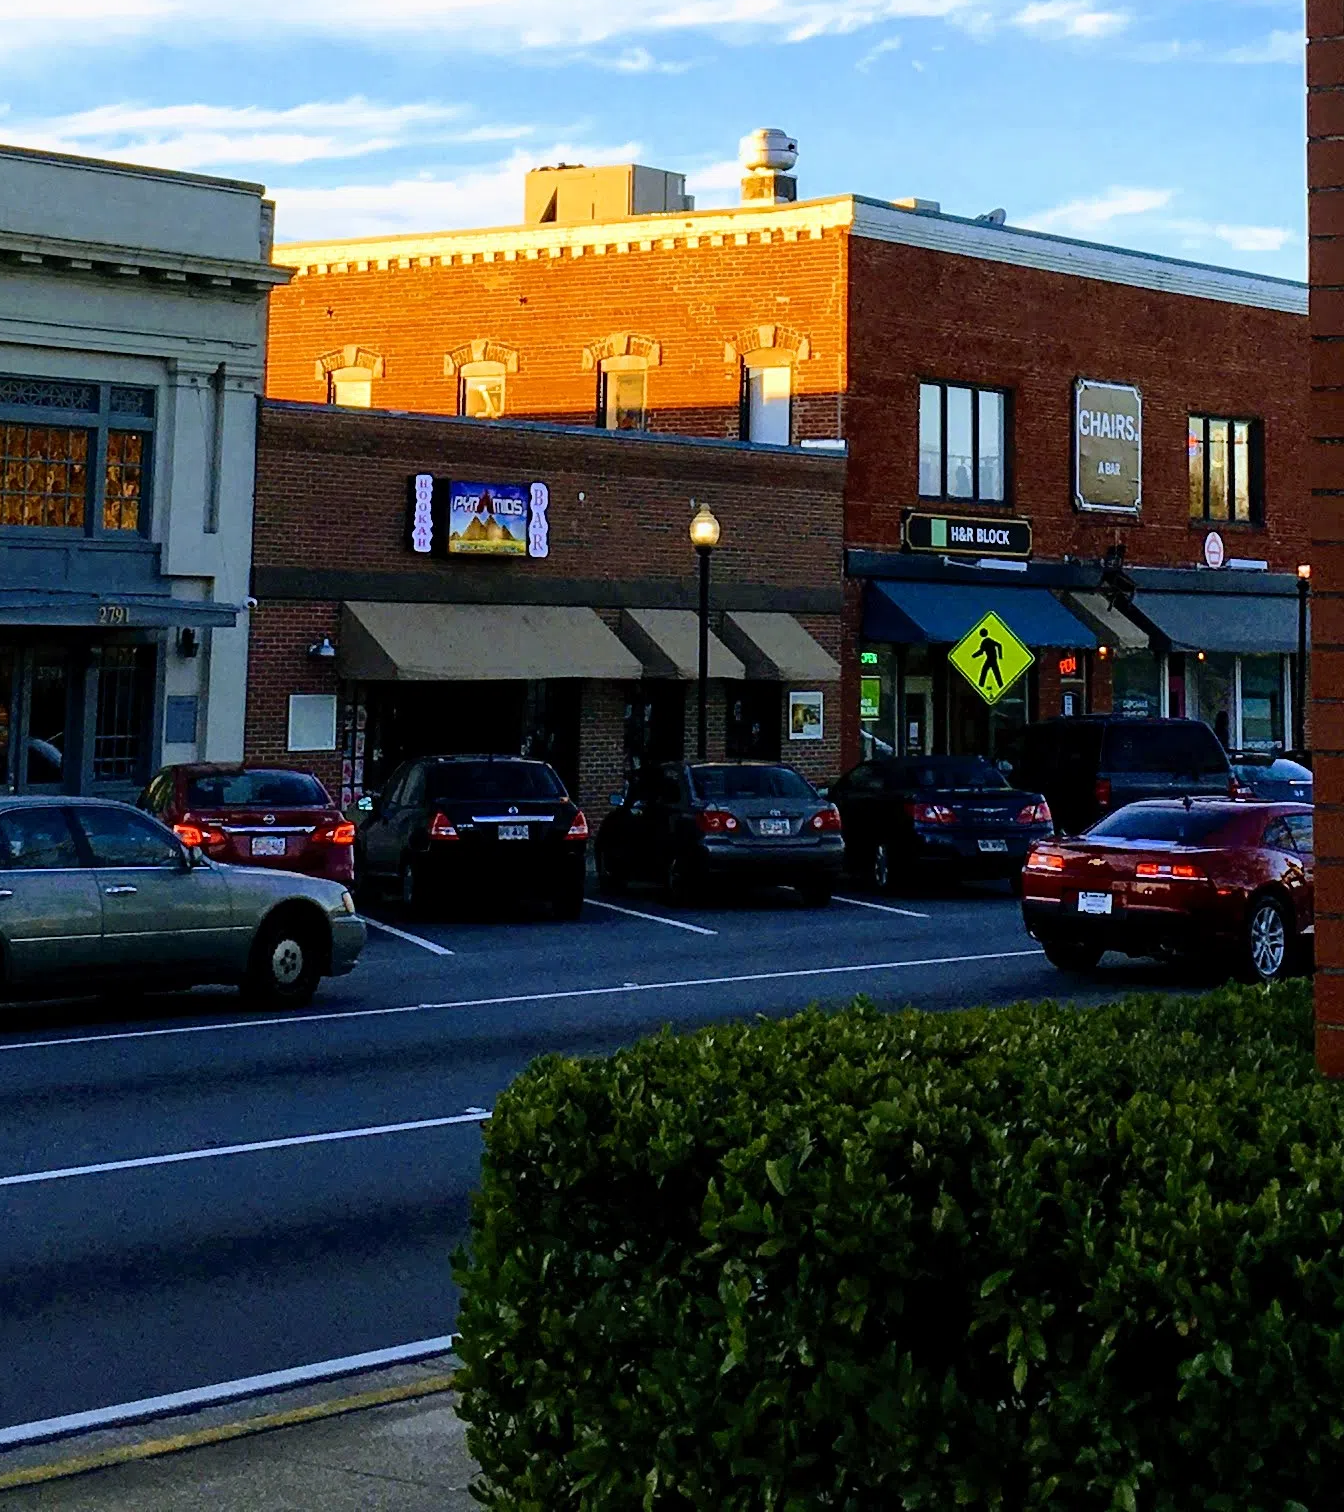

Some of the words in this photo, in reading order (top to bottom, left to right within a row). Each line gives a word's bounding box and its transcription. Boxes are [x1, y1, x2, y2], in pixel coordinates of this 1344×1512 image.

[1097, 461, 1104, 474] A
[418, 479, 428, 547] HOOKAH
[533, 489, 544, 551] BAR
[950, 526, 974, 543] H&R
[976, 528, 1011, 545] BLOCK
[98, 606, 130, 625] 2791
